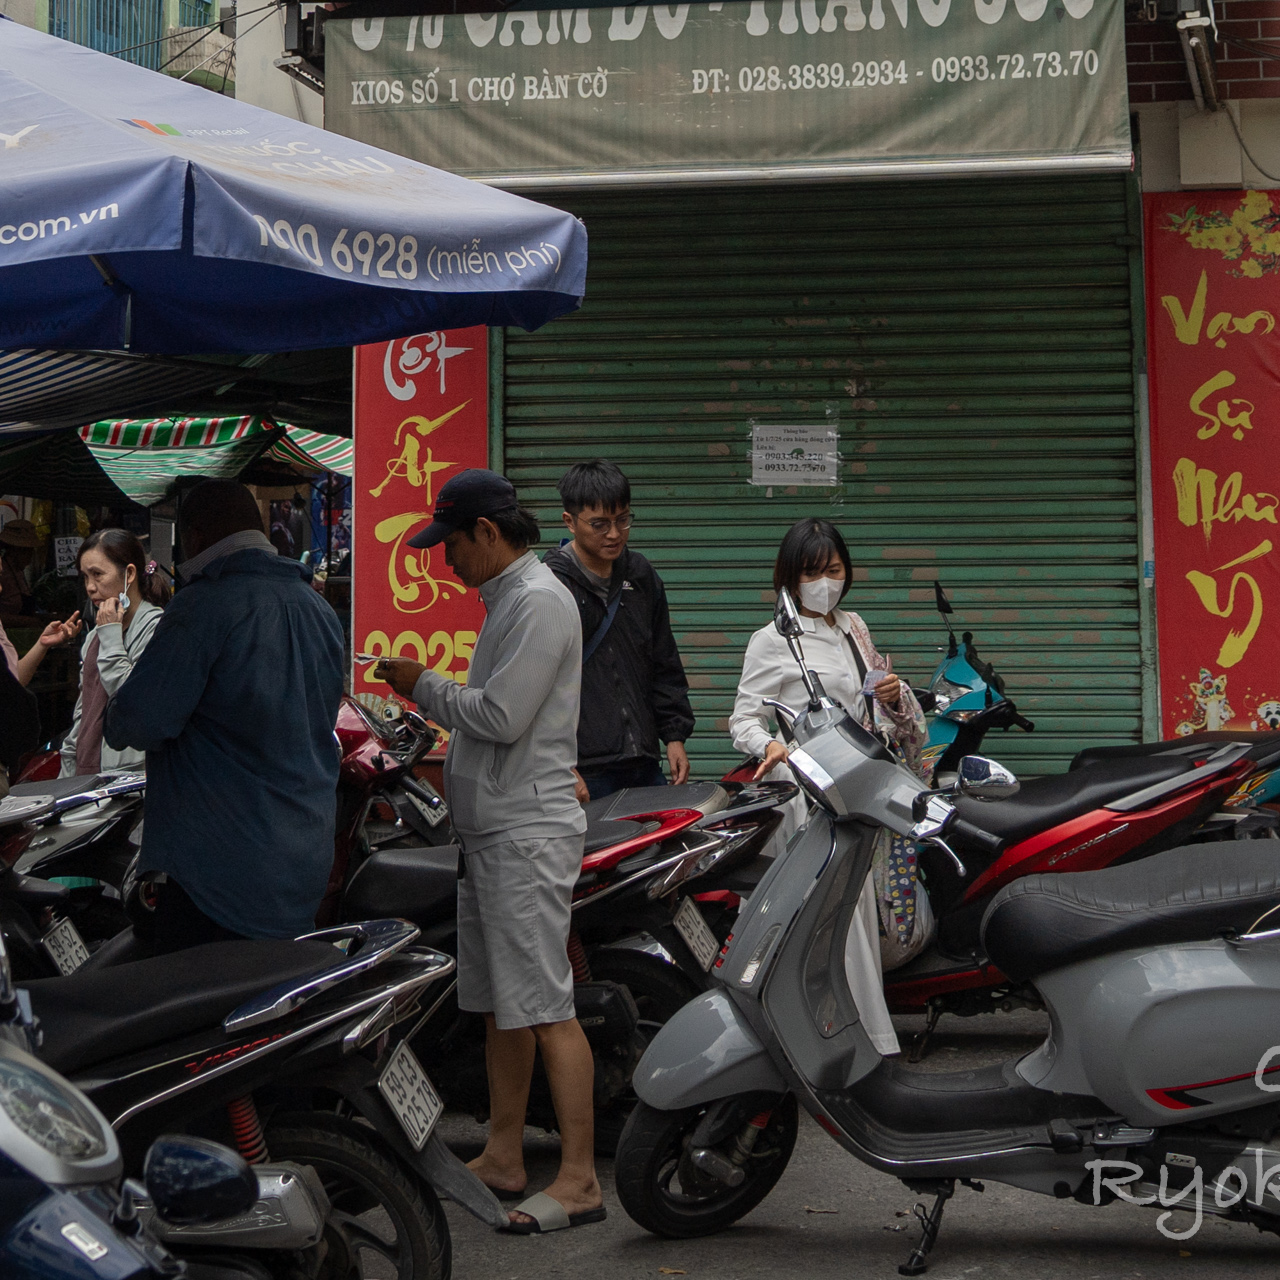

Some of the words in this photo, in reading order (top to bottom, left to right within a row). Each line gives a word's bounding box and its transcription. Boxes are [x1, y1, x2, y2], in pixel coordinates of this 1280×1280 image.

[351, 79, 405, 105] KIOS
[411, 66, 441, 104] SỐ
[448, 78, 460, 102] 1
[467, 72, 517, 107] CHỢ
[523, 68, 570, 101] BÀN
[577, 66, 609, 99] CỜ
[692, 68, 730, 95] ĐT:
[738, 59, 909, 92] 028.3839.2934
[931, 49, 1100, 84] 0933.72.73.70
[211, 126, 251, 137] Retail
[271, 155, 395, 177] CHÂU
[331, 228, 418, 280] 6928
[426, 237, 503, 281] (miễn
[504, 241, 562, 277] phí)
[1161, 268, 1275, 349] Vạn
[1189, 370, 1255, 441] Sự
[1171, 456, 1280, 550] Như
[1185, 538, 1273, 669] Ý
[47, 924, 78, 959] 59-S2
[385, 1051, 419, 1106] 59-C3
[401, 1079, 439, 1142] 025.78
